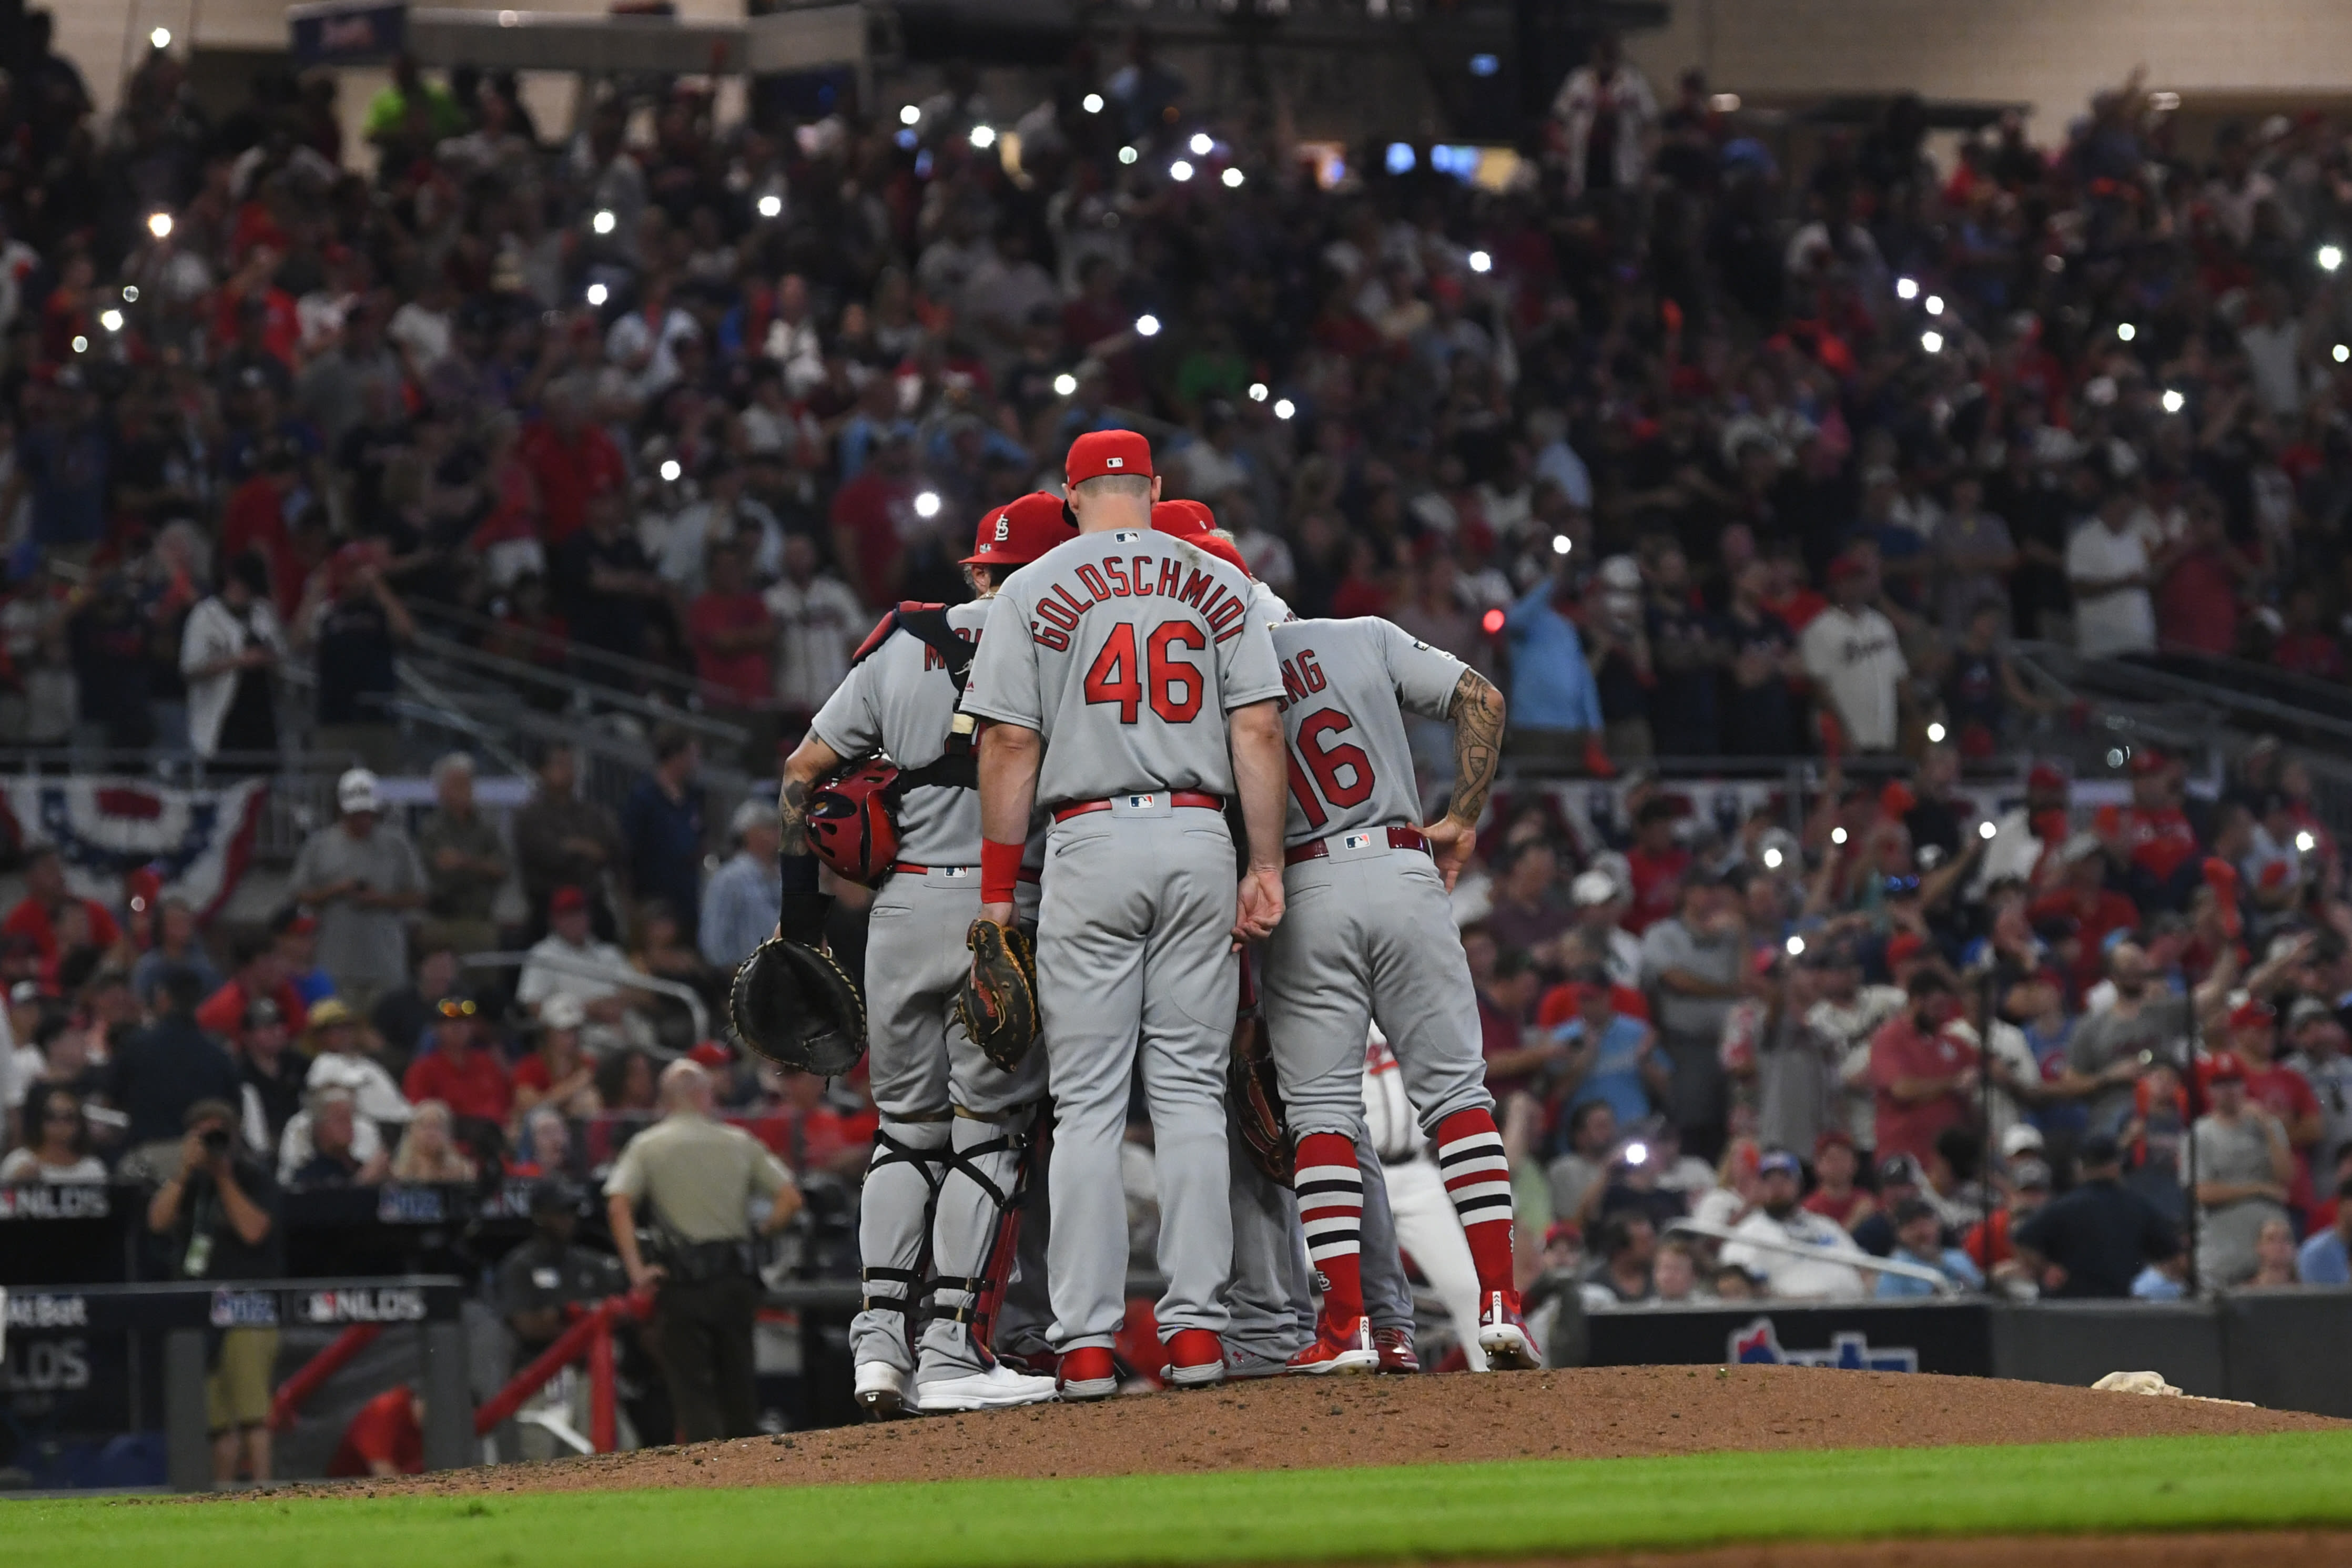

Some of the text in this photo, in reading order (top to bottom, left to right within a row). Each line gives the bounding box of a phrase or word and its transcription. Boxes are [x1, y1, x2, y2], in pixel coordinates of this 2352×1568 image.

[1084, 620, 1206, 724] 46
[1285, 707, 1375, 830] 16
[335, 1288, 426, 1320] NLDS
